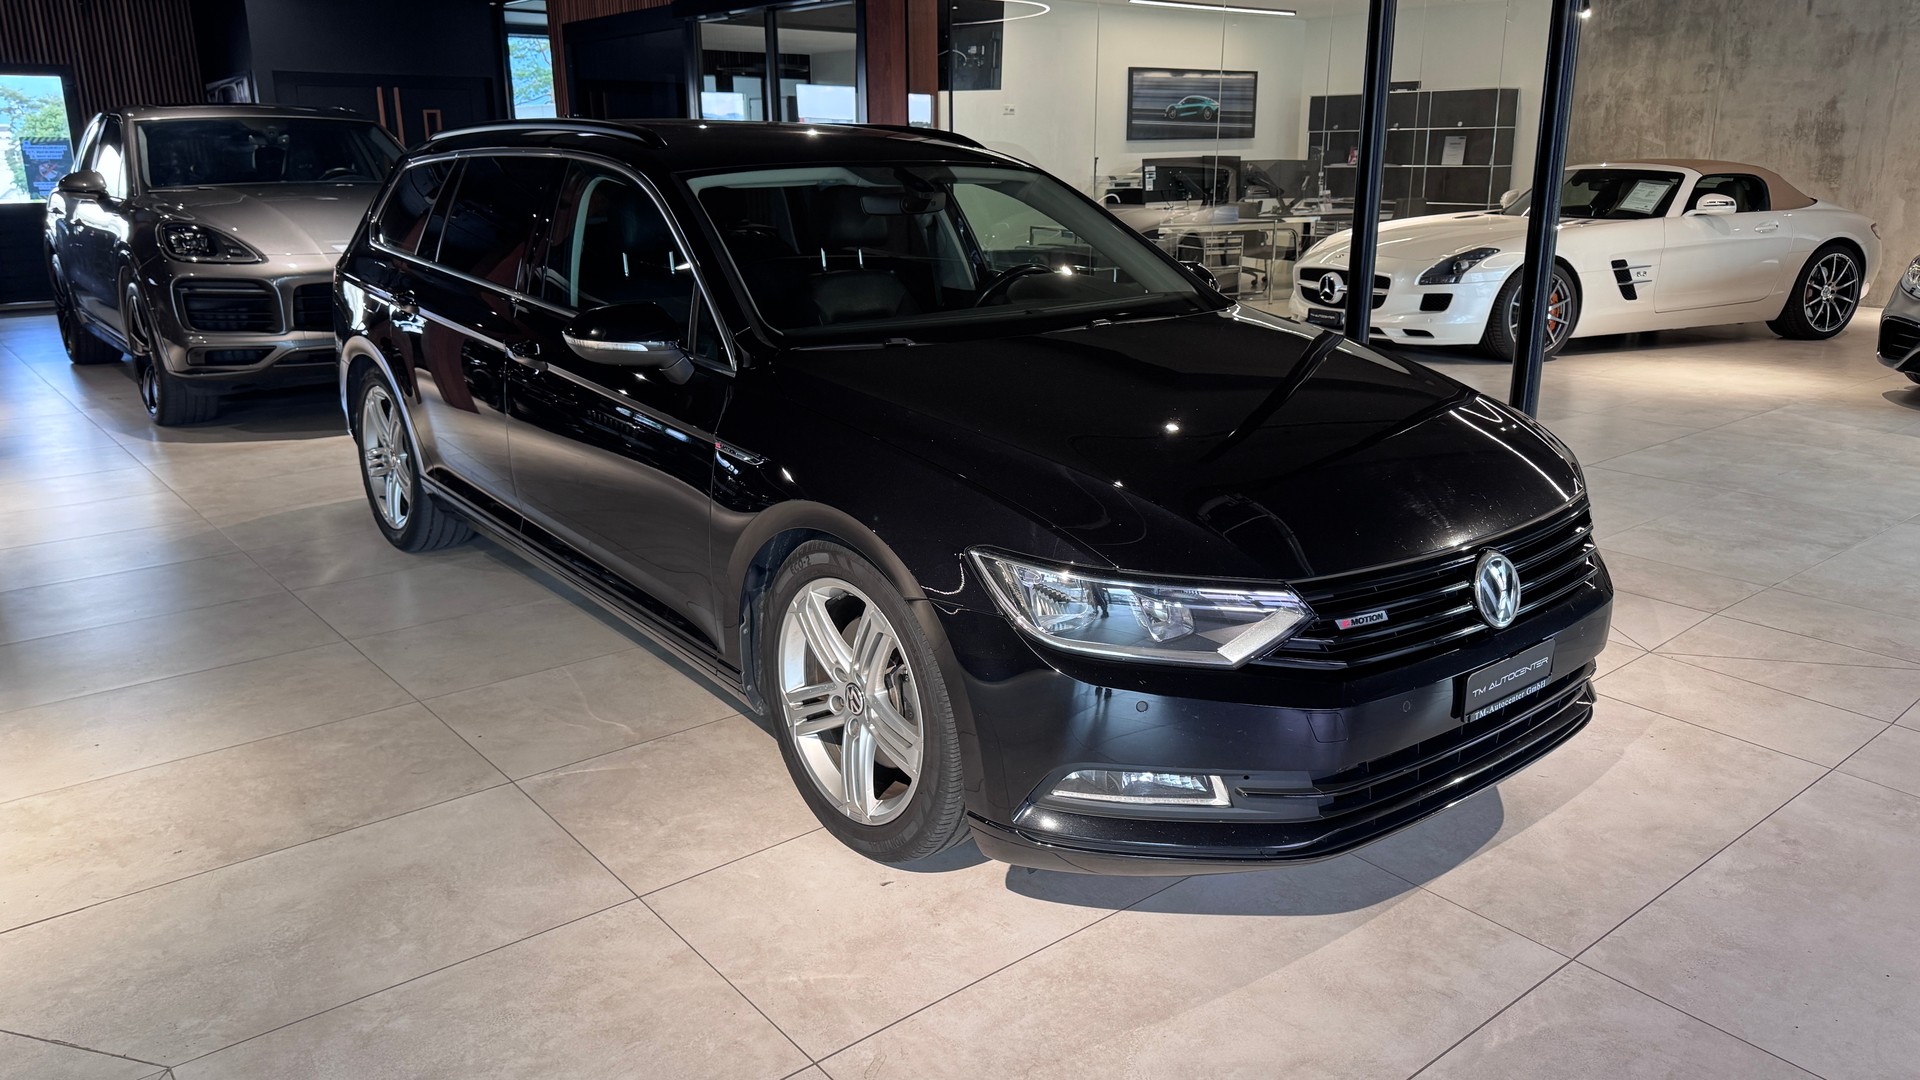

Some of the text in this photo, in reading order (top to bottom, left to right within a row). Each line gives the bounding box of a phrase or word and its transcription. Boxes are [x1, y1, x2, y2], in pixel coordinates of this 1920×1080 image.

[1472, 656, 1549, 697] TM AUTOCENTER
[1475, 680, 1546, 720] TM-Autocenter GmbH
